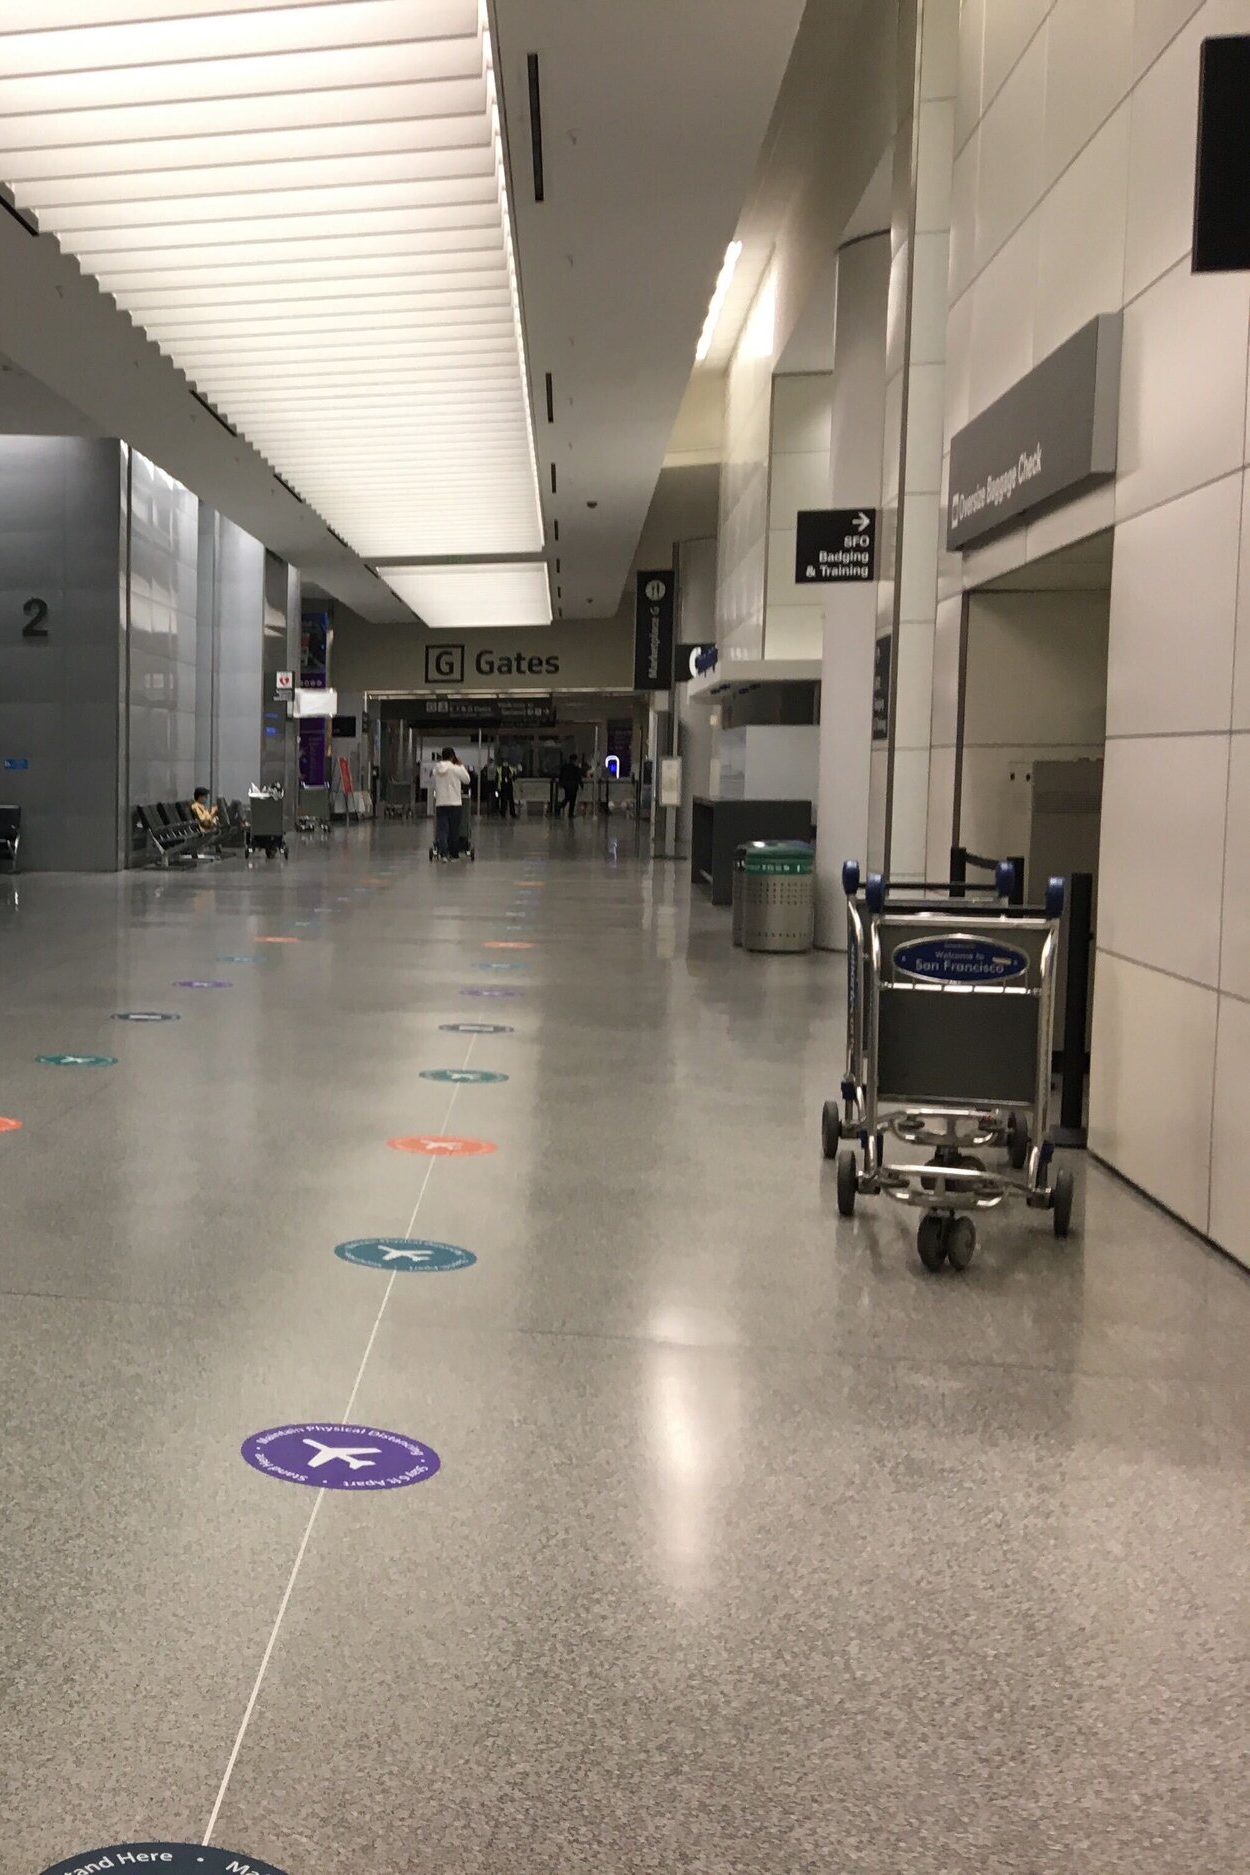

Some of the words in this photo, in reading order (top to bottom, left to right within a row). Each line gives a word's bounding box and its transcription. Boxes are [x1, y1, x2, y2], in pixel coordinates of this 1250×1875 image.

[986, 465, 1017, 507] Baggage
[1017, 441, 1042, 485] Check
[844, 535, 870, 548] SFO
[819, 550, 869, 565] Badging
[806, 565, 816, 578] &
[820, 564, 869, 578] Training
[22, 597, 48, 637] 2
[648, 616, 661, 679] Marketplace
[435, 651, 455, 675] G
[475, 649, 560, 675] Gates
[935, 951, 973, 960] Welcome
[975, 952, 986, 960] to
[915, 958, 939, 972] San
[944, 959, 1005, 974] Francisco
[305, 1425, 366, 1434] Physical
[342, 1479, 387, 1488] Apart
[64, 1855, 115, 1875] tand
[116, 1851, 174, 1866] Here
